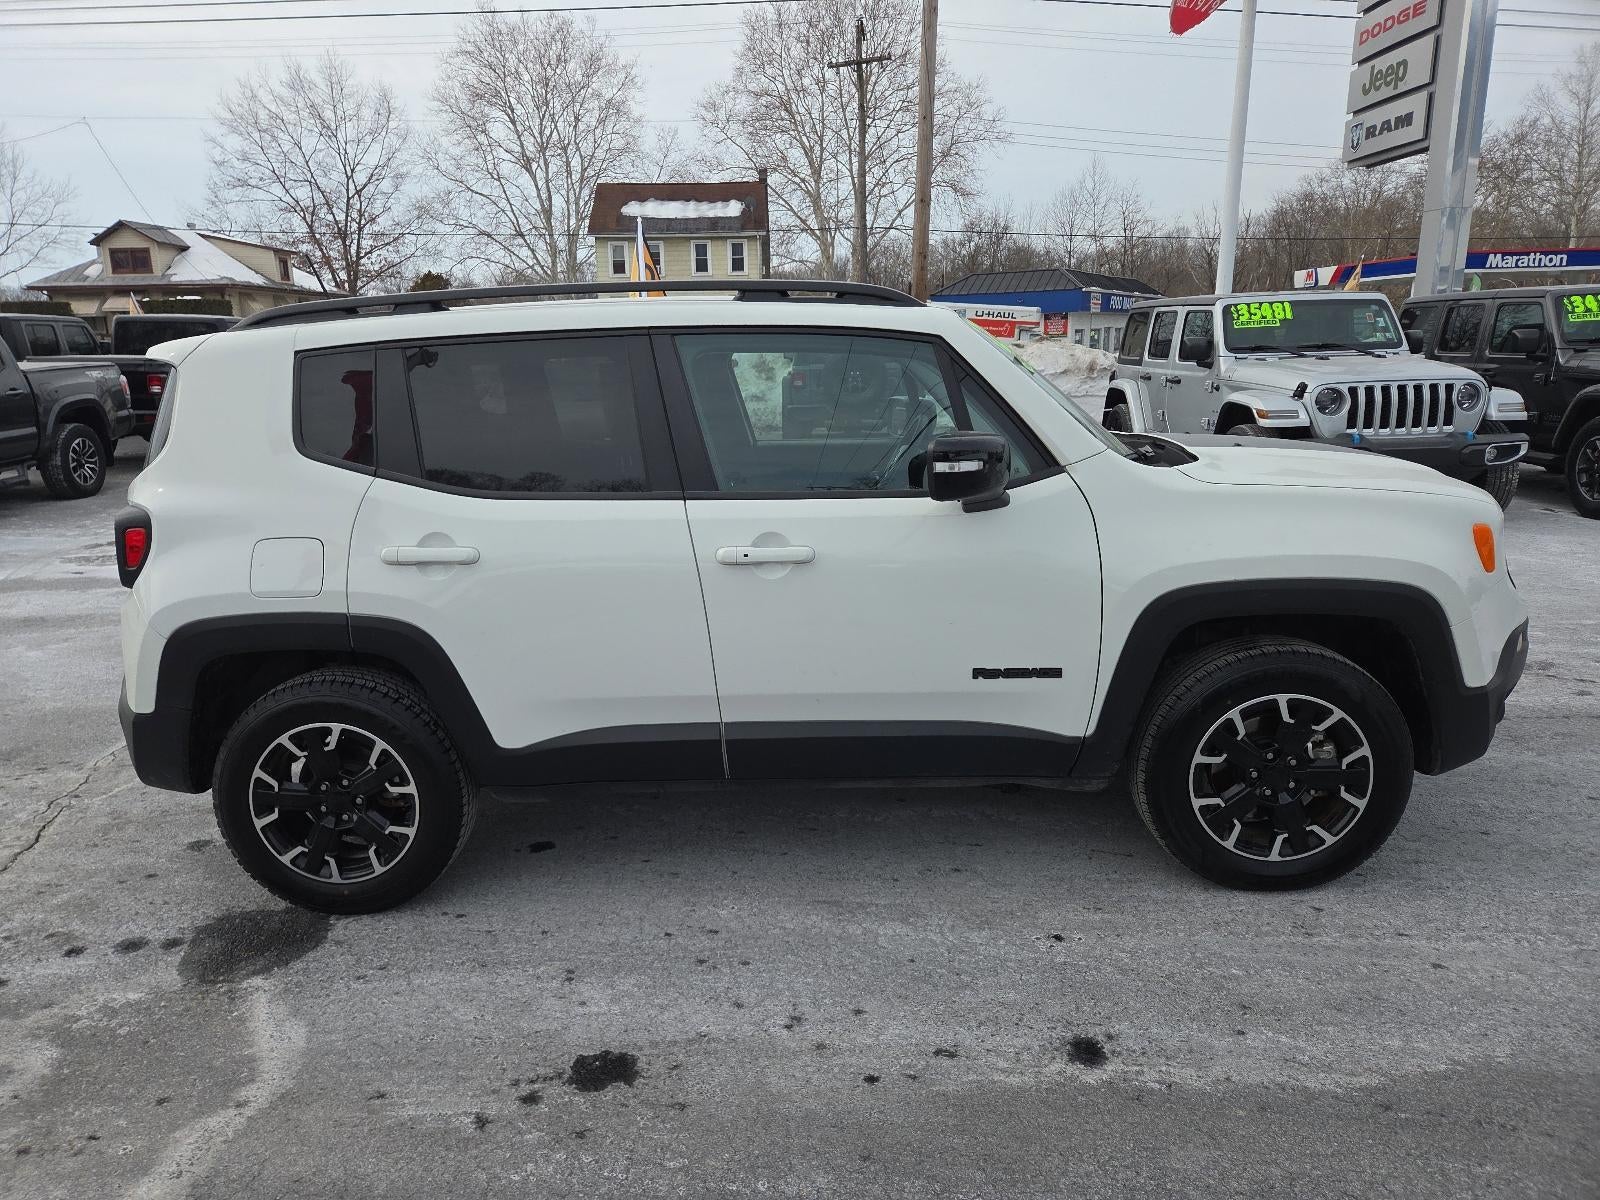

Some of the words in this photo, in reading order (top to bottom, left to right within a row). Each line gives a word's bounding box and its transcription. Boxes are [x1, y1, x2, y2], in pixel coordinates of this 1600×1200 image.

[1359, 0, 1427, 46] DODGE
[1361, 58, 1408, 96] Jeep
[1364, 111, 1414, 140] RAM
[1485, 252, 1568, 268] Marathon
[1109, 295, 1123, 309] FOOD
[975, 310, 1017, 319] U-HAUL
[1234, 319, 1278, 327] CERTIFIED
